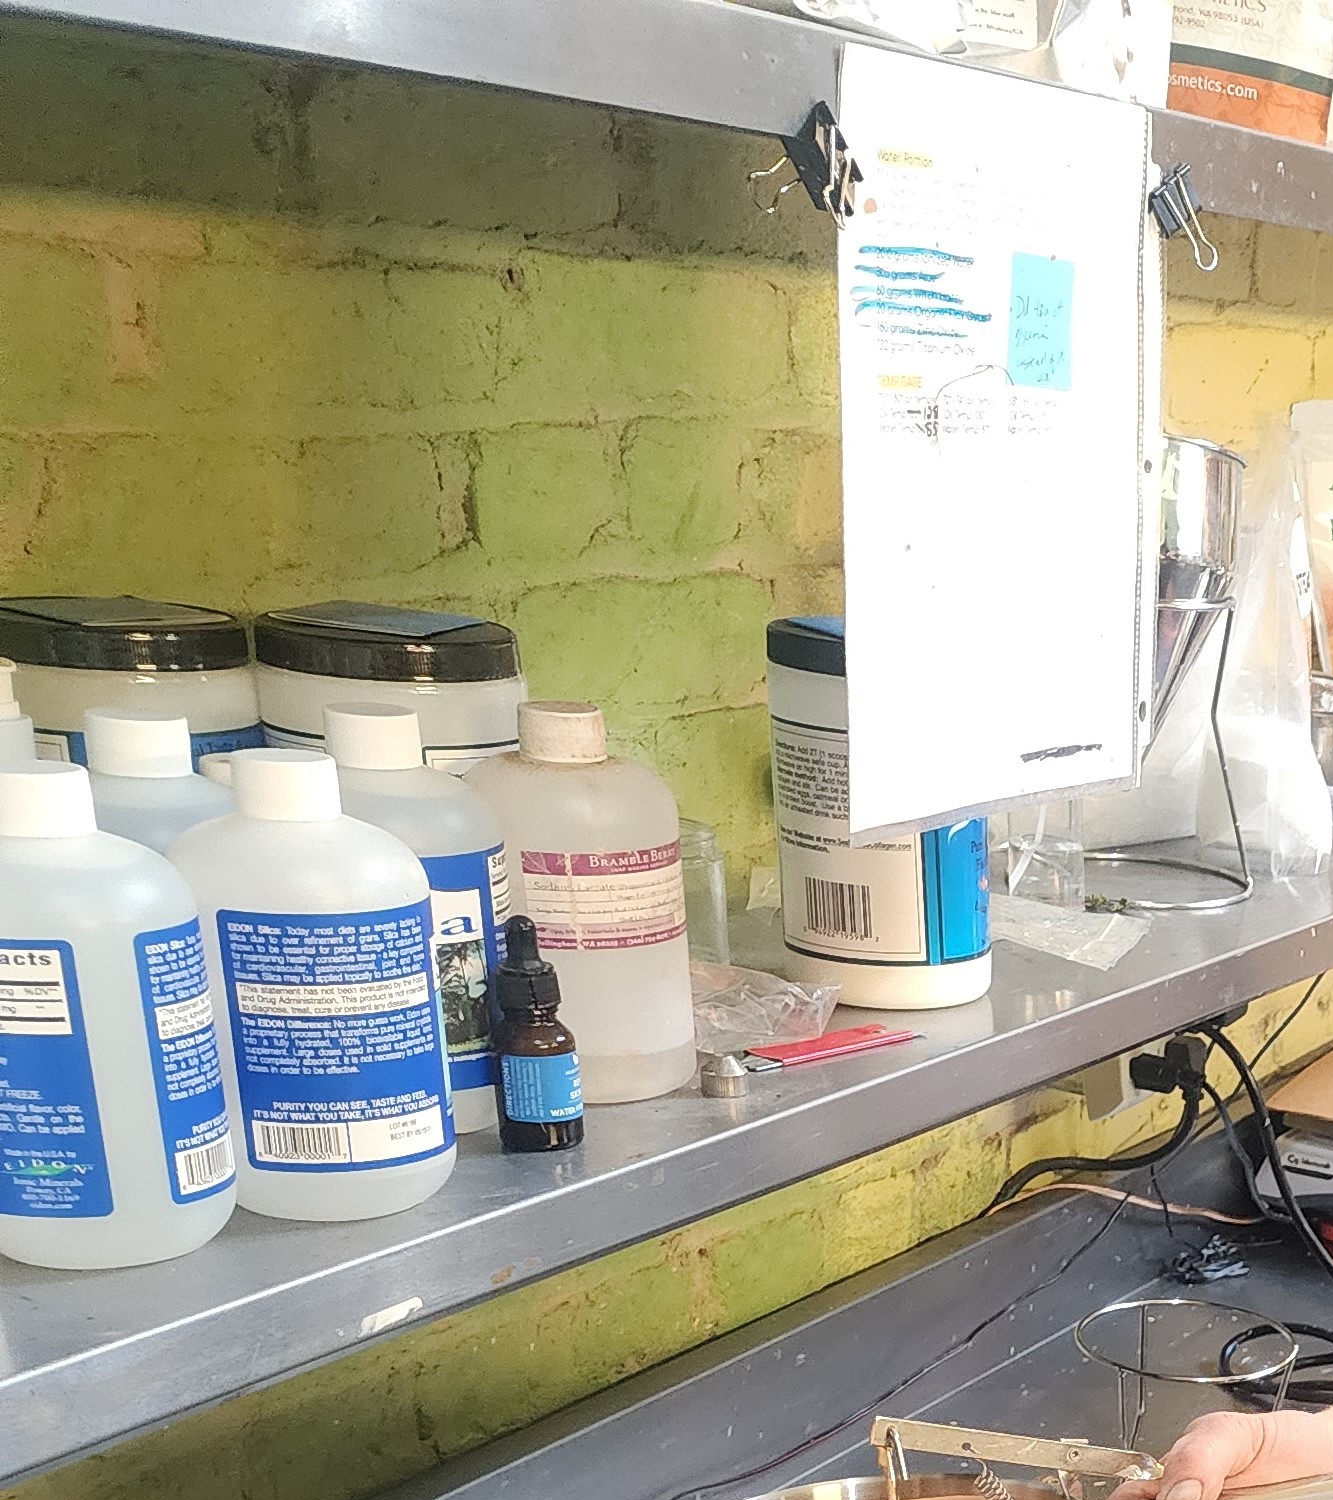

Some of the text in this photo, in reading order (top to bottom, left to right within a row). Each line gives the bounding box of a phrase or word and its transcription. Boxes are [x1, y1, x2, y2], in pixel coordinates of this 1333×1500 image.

[588, 851, 649, 868] BRAMBLE
[261, 986, 301, 995] statement
[304, 987, 318, 995] has
[321, 987, 335, 995] not
[256, 995, 277, 1005] Drug
[341, 995, 358, 1004] This
[359, 993, 387, 1004] product
[241, 1003, 250, 1011] to
[334, 1006, 343, 1014] or
[273, 1101, 306, 1111] PURITY
[307, 1102, 328, 1112] YOU
[329, 1101, 350, 1111] CAN
[350, 1100, 371, 1109] SEE,
[370, 1096, 397, 1108] TASTE
[396, 1093, 412, 1105] AND
[253, 1101, 418, 1121] IT'S NOT WHAT YOU TAKE, IT'S WHAT YOU
[550, 1106, 576, 1116] WATER
